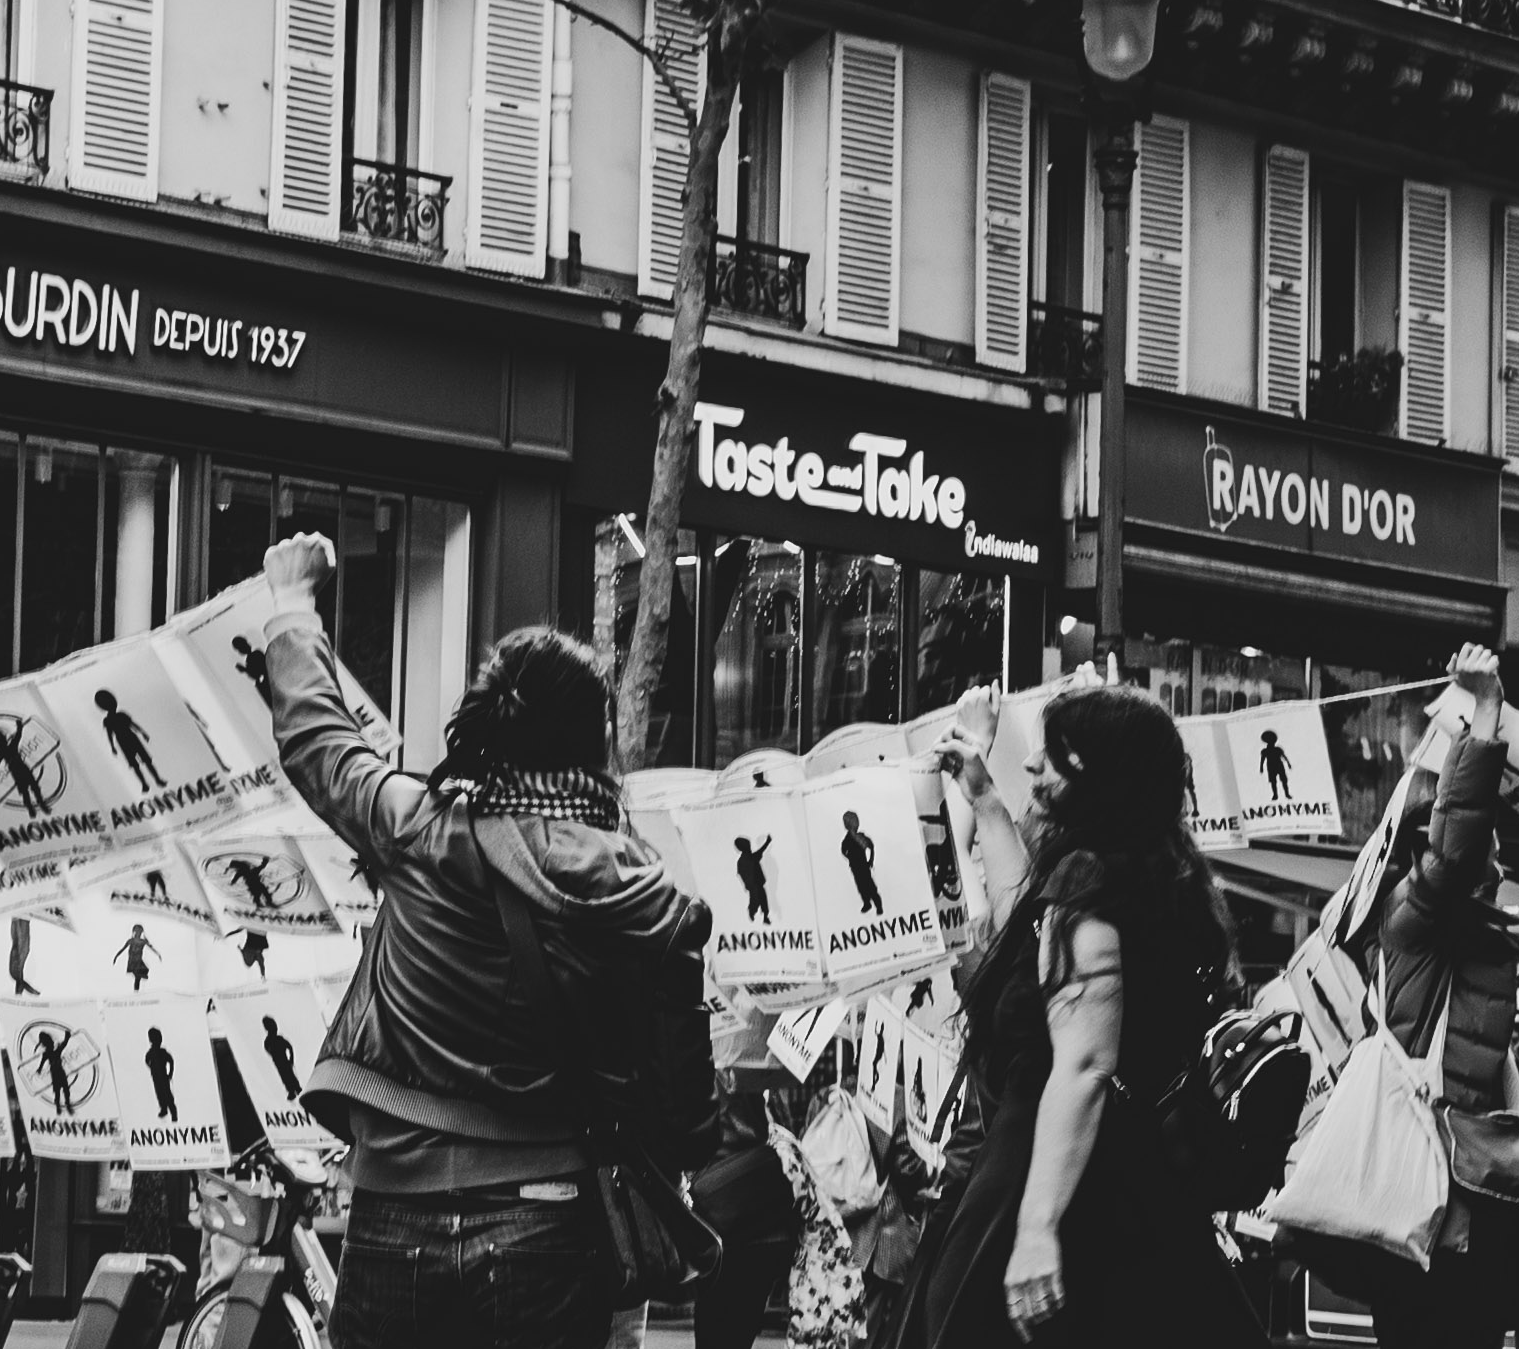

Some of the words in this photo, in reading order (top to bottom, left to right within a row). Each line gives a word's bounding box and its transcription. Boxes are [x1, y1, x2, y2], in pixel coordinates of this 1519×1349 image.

[153, 307, 240, 360] DEPUIS
[248, 325, 306, 369] 1937
[693, 402, 822, 501] Taste
[849, 433, 965, 530] Take
[1210, 454, 1330, 531] RAYON
[1341, 482, 1416, 547] D'OR
[111, 770, 226, 830] ANONYME
[717, 931, 814, 954] ANONYME
[829, 909, 933, 954] ANONYME
[30, 1117, 121, 1139] ANONYME
[130, 1123, 221, 1147] ANONYME
[265, 1110, 311, 1130] ANON
